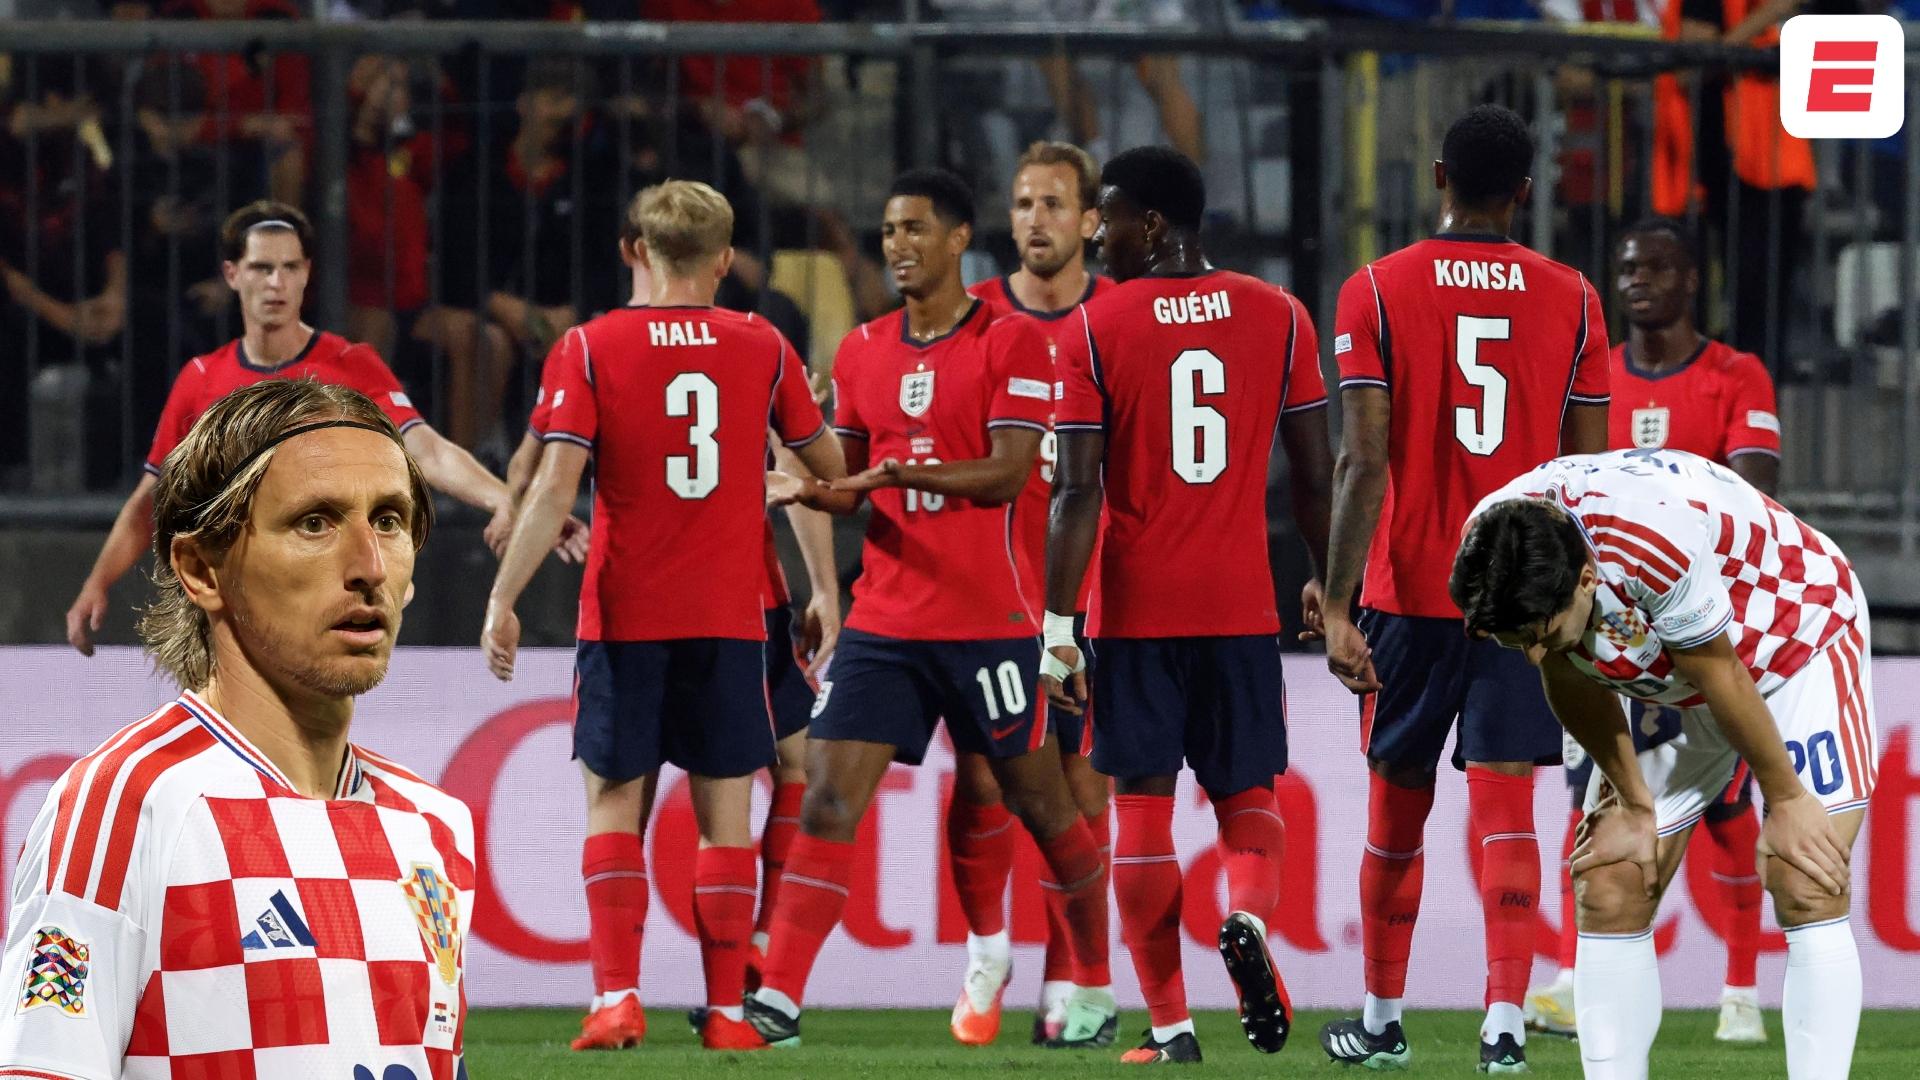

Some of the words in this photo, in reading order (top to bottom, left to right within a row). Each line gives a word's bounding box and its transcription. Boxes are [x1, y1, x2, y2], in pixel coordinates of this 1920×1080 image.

[1434, 259, 1526, 291] KONSA
[1153, 291, 1231, 324] GUÉHI
[648, 321, 717, 346] HALL
[1456, 315, 1510, 455] 5
[665, 373, 720, 499] 3
[1171, 349, 1227, 484] 6
[976, 660, 1027, 720] 10
[1500, 892, 1531, 908] ENG
